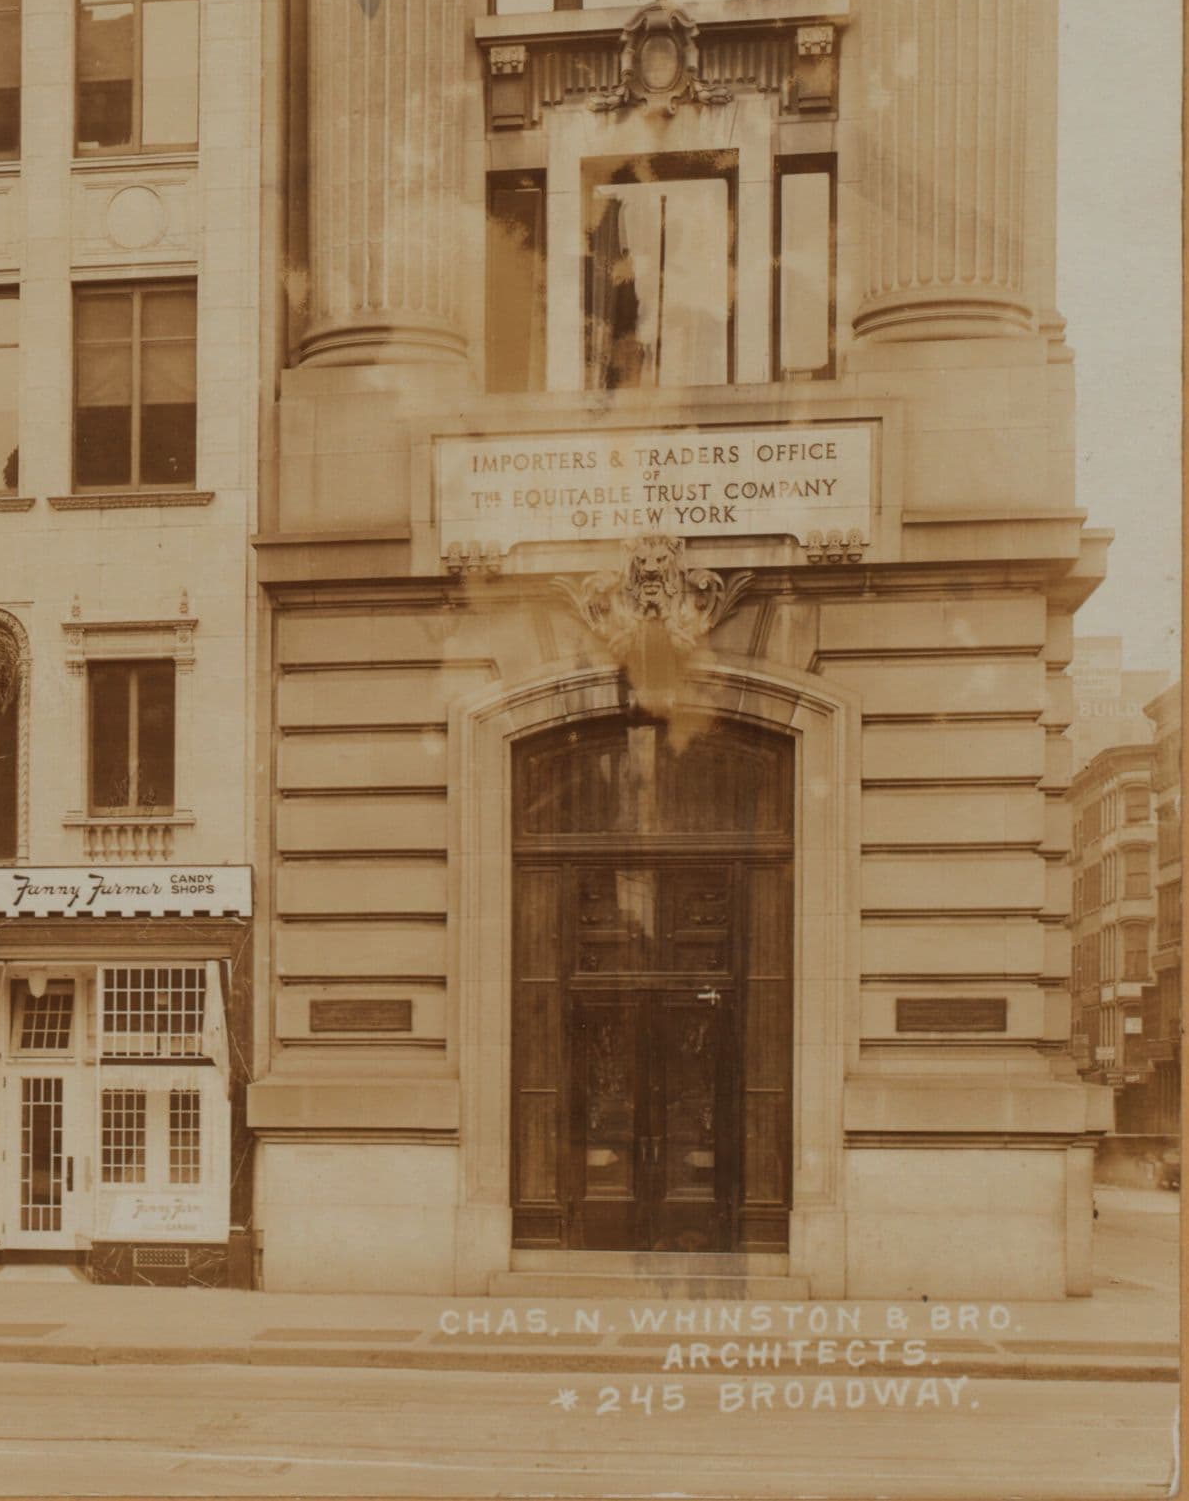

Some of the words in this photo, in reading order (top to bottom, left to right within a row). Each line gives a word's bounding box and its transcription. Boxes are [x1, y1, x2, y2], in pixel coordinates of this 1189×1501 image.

[471, 450, 598, 474] IMPORTERS
[610, 453, 625, 467] &
[636, 444, 740, 467] TRADERS
[756, 442, 838, 463] OFFICE
[643, 470, 661, 481] OF
[513, 486, 631, 509] EQUITABLE
[643, 483, 712, 503] TRUST
[723, 478, 838, 500] COMPANY
[571, 509, 602, 528] OF
[613, 507, 664, 528] NEW
[674, 505, 738, 525] YORK
[13, 874, 82, 908] Fanny
[86, 873, 163, 906] Farmer
[170, 874, 214, 884] CANDY
[171, 884, 215, 894] SHOPS
